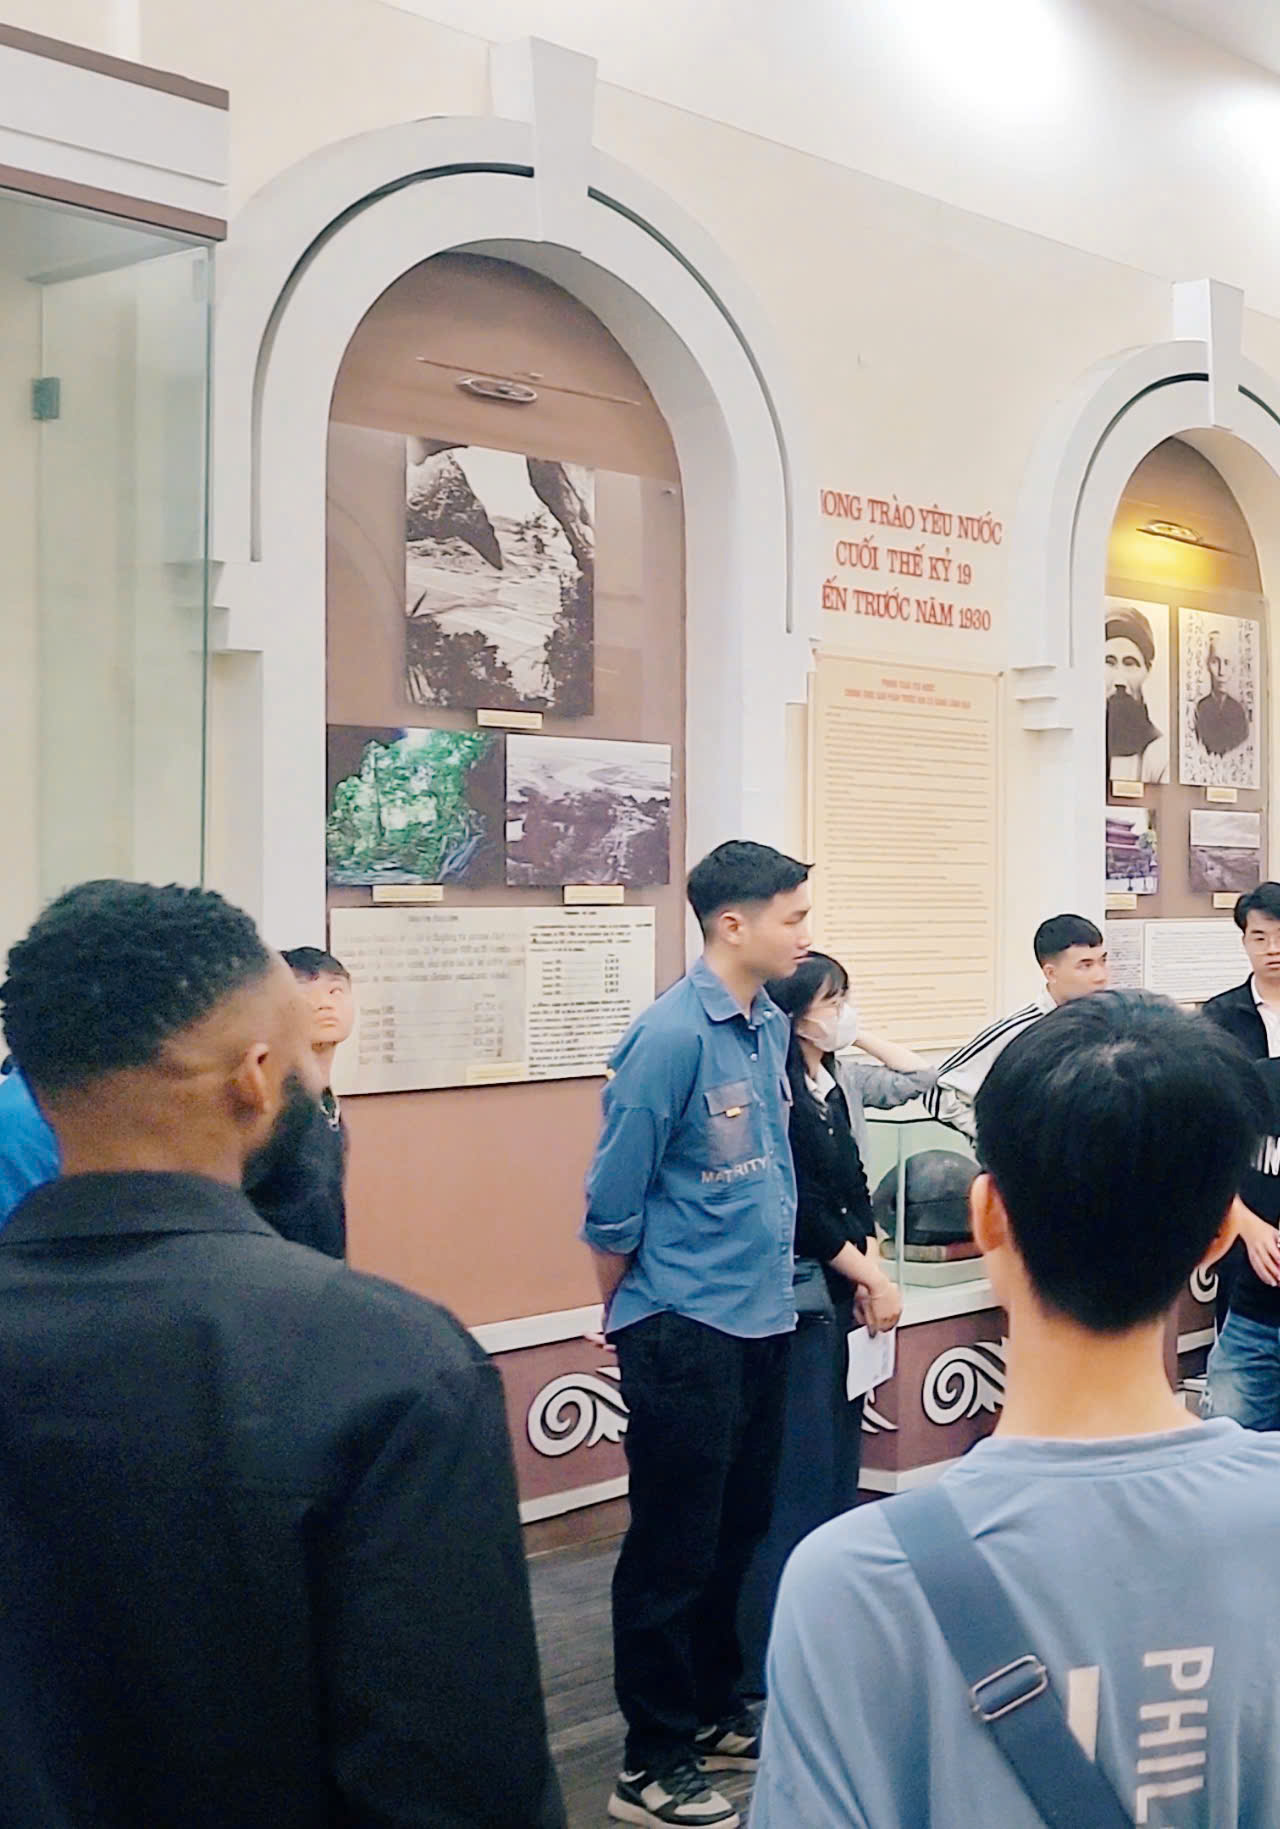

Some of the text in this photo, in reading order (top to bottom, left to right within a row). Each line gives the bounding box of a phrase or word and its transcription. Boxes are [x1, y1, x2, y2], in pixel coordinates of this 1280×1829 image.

[821, 489, 1003, 545] ONG TRÀO YÊU NƯỚC
[836, 535, 972, 585] CUỐI THẾ KỶ 19
[821, 576, 991, 631] ẾN TRƯỚC NĂM 1930
[1136, 1647, 1214, 1829] PHIL
